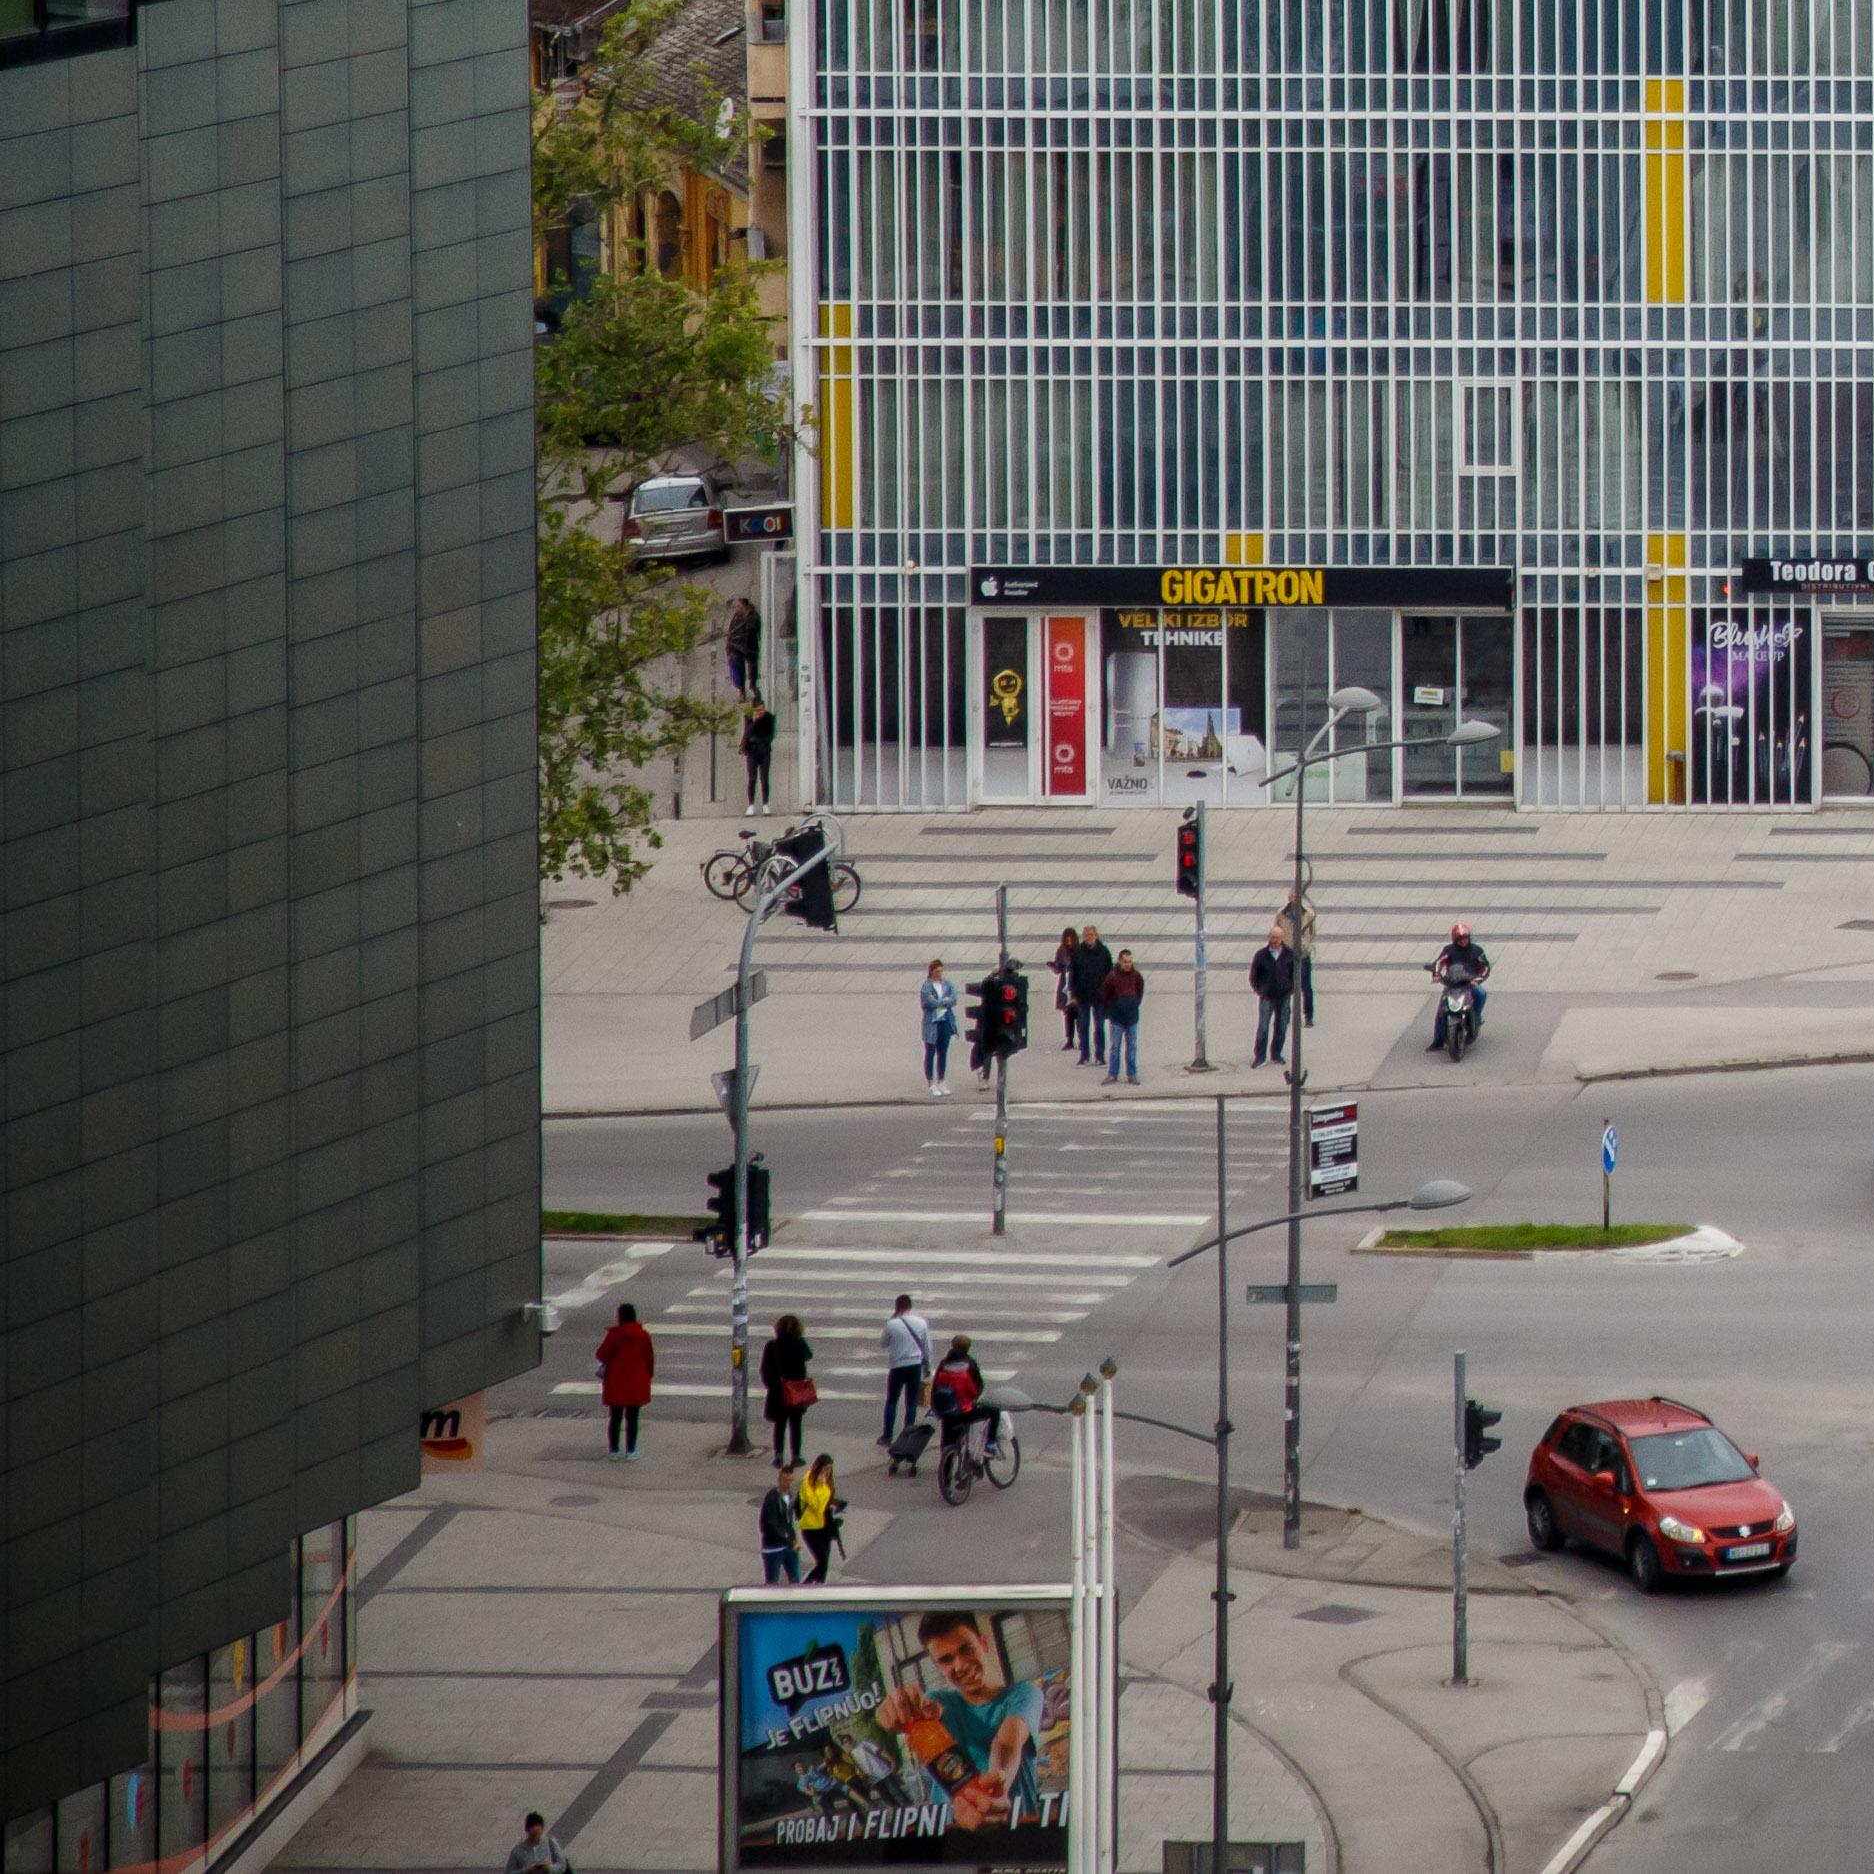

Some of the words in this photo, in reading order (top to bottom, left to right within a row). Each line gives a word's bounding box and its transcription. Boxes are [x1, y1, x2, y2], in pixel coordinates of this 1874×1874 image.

[1770, 560, 1857, 582] Teodora
[1161, 569, 1326, 606] GIGATRON
[1053, 664, 1073, 674] mts
[1053, 765, 1074, 775] mts
[1107, 776, 1149, 791] VAŽNO
[766, 1728, 790, 1750] JE
[788, 1681, 883, 1741] FLIPNUO!
[776, 1814, 840, 1846] PROBAJ
[847, 1811, 857, 1842] I
[863, 1802, 948, 1840] FLIPNI
[1010, 1795, 1022, 1830] I
